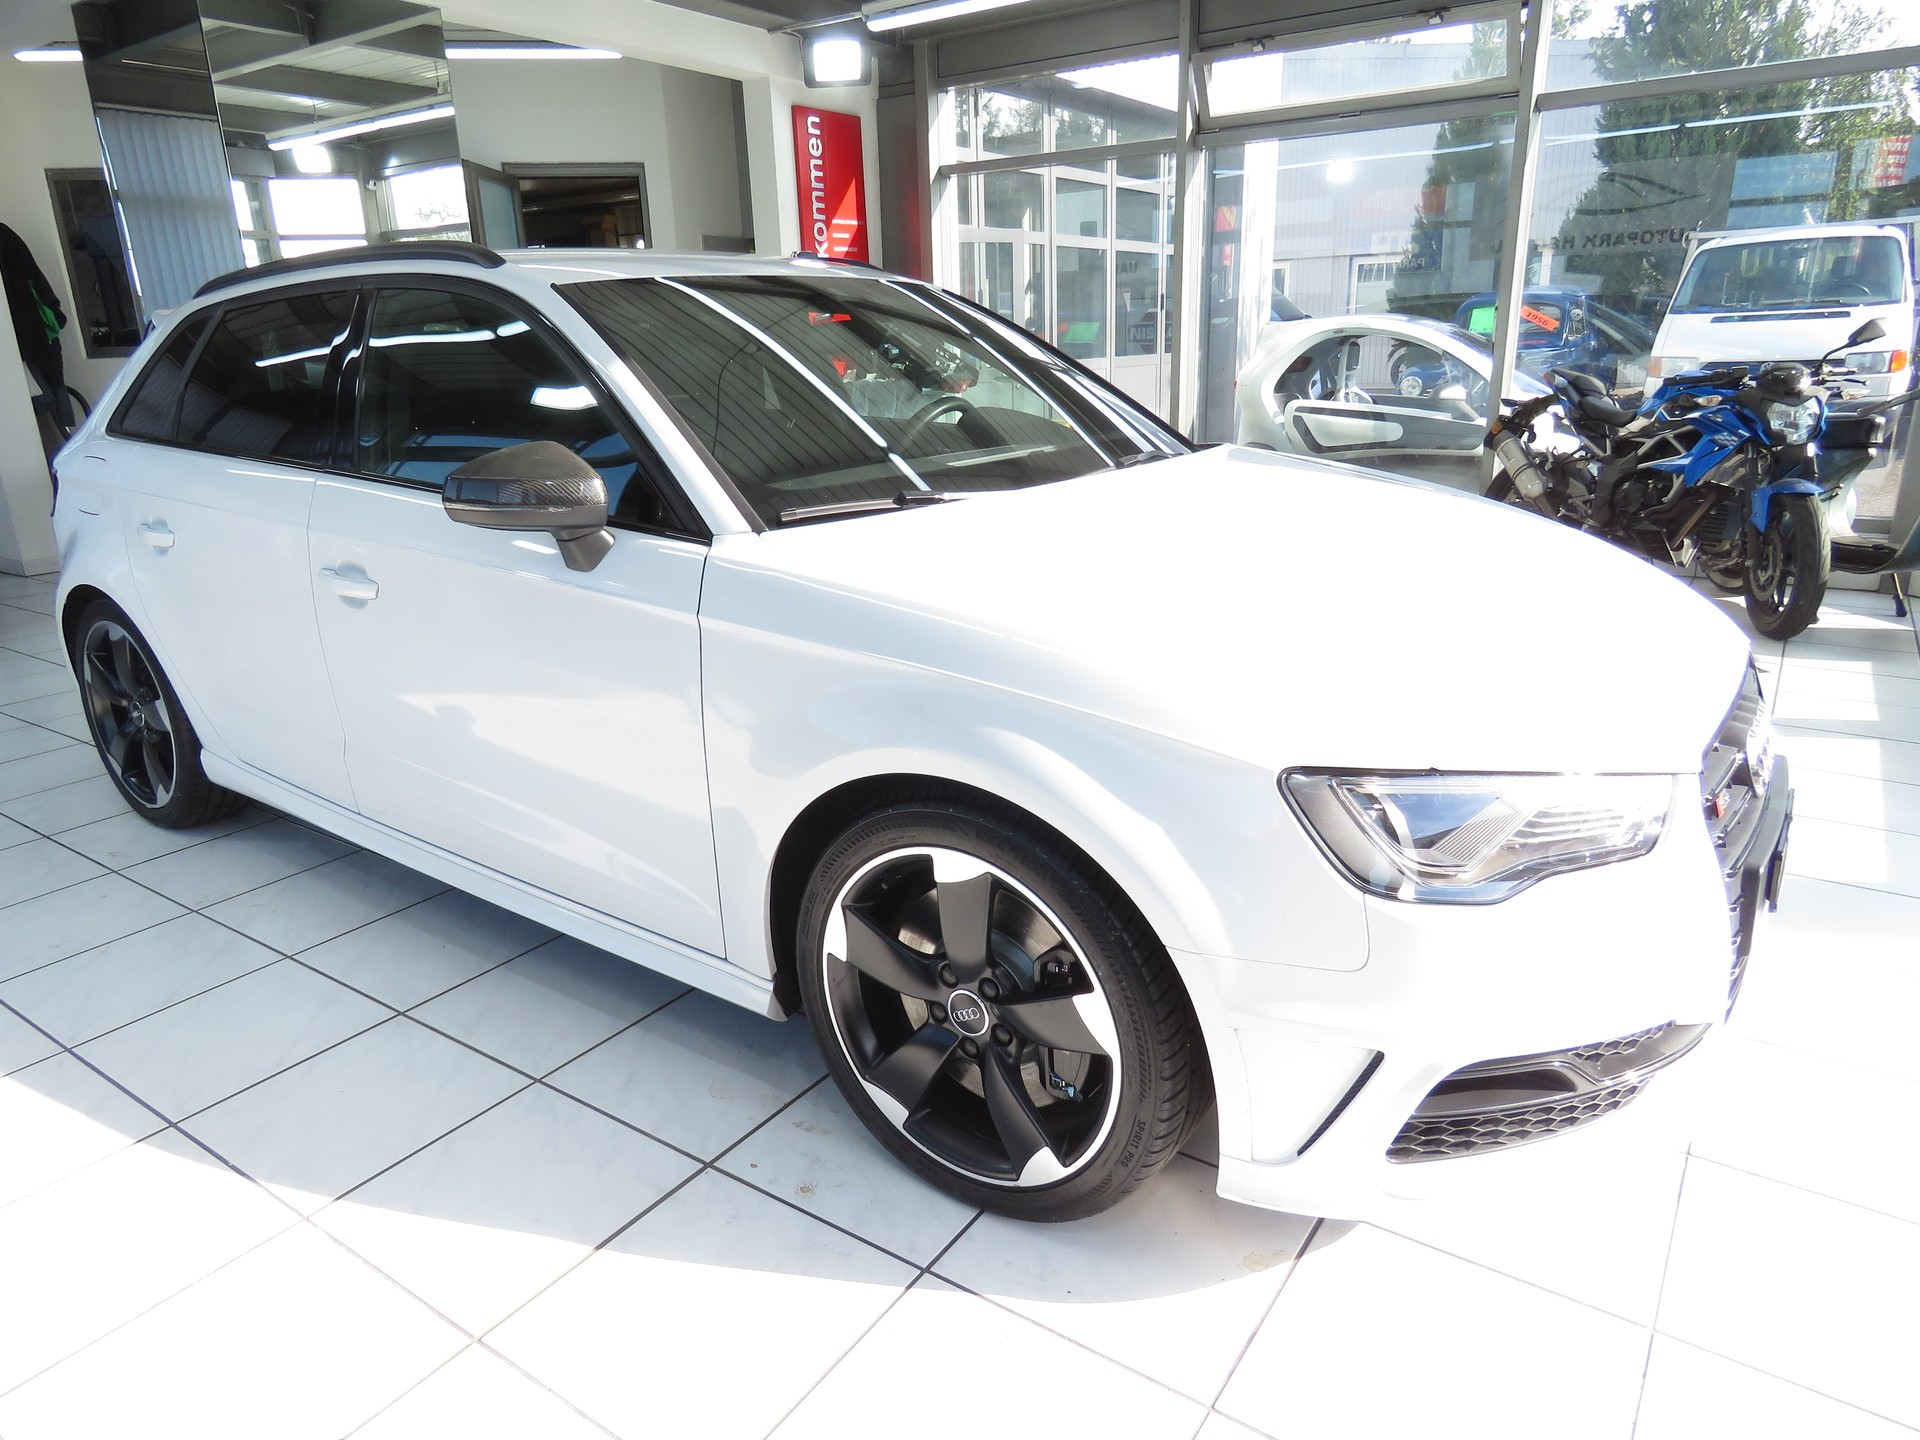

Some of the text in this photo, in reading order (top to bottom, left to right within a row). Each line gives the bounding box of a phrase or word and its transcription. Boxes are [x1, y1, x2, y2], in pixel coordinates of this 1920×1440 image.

[806, 115, 829, 258] kommen
[1526, 311, 1549, 327] 1956
[1120, 1119, 1146, 1168] SPIRIT PRO
